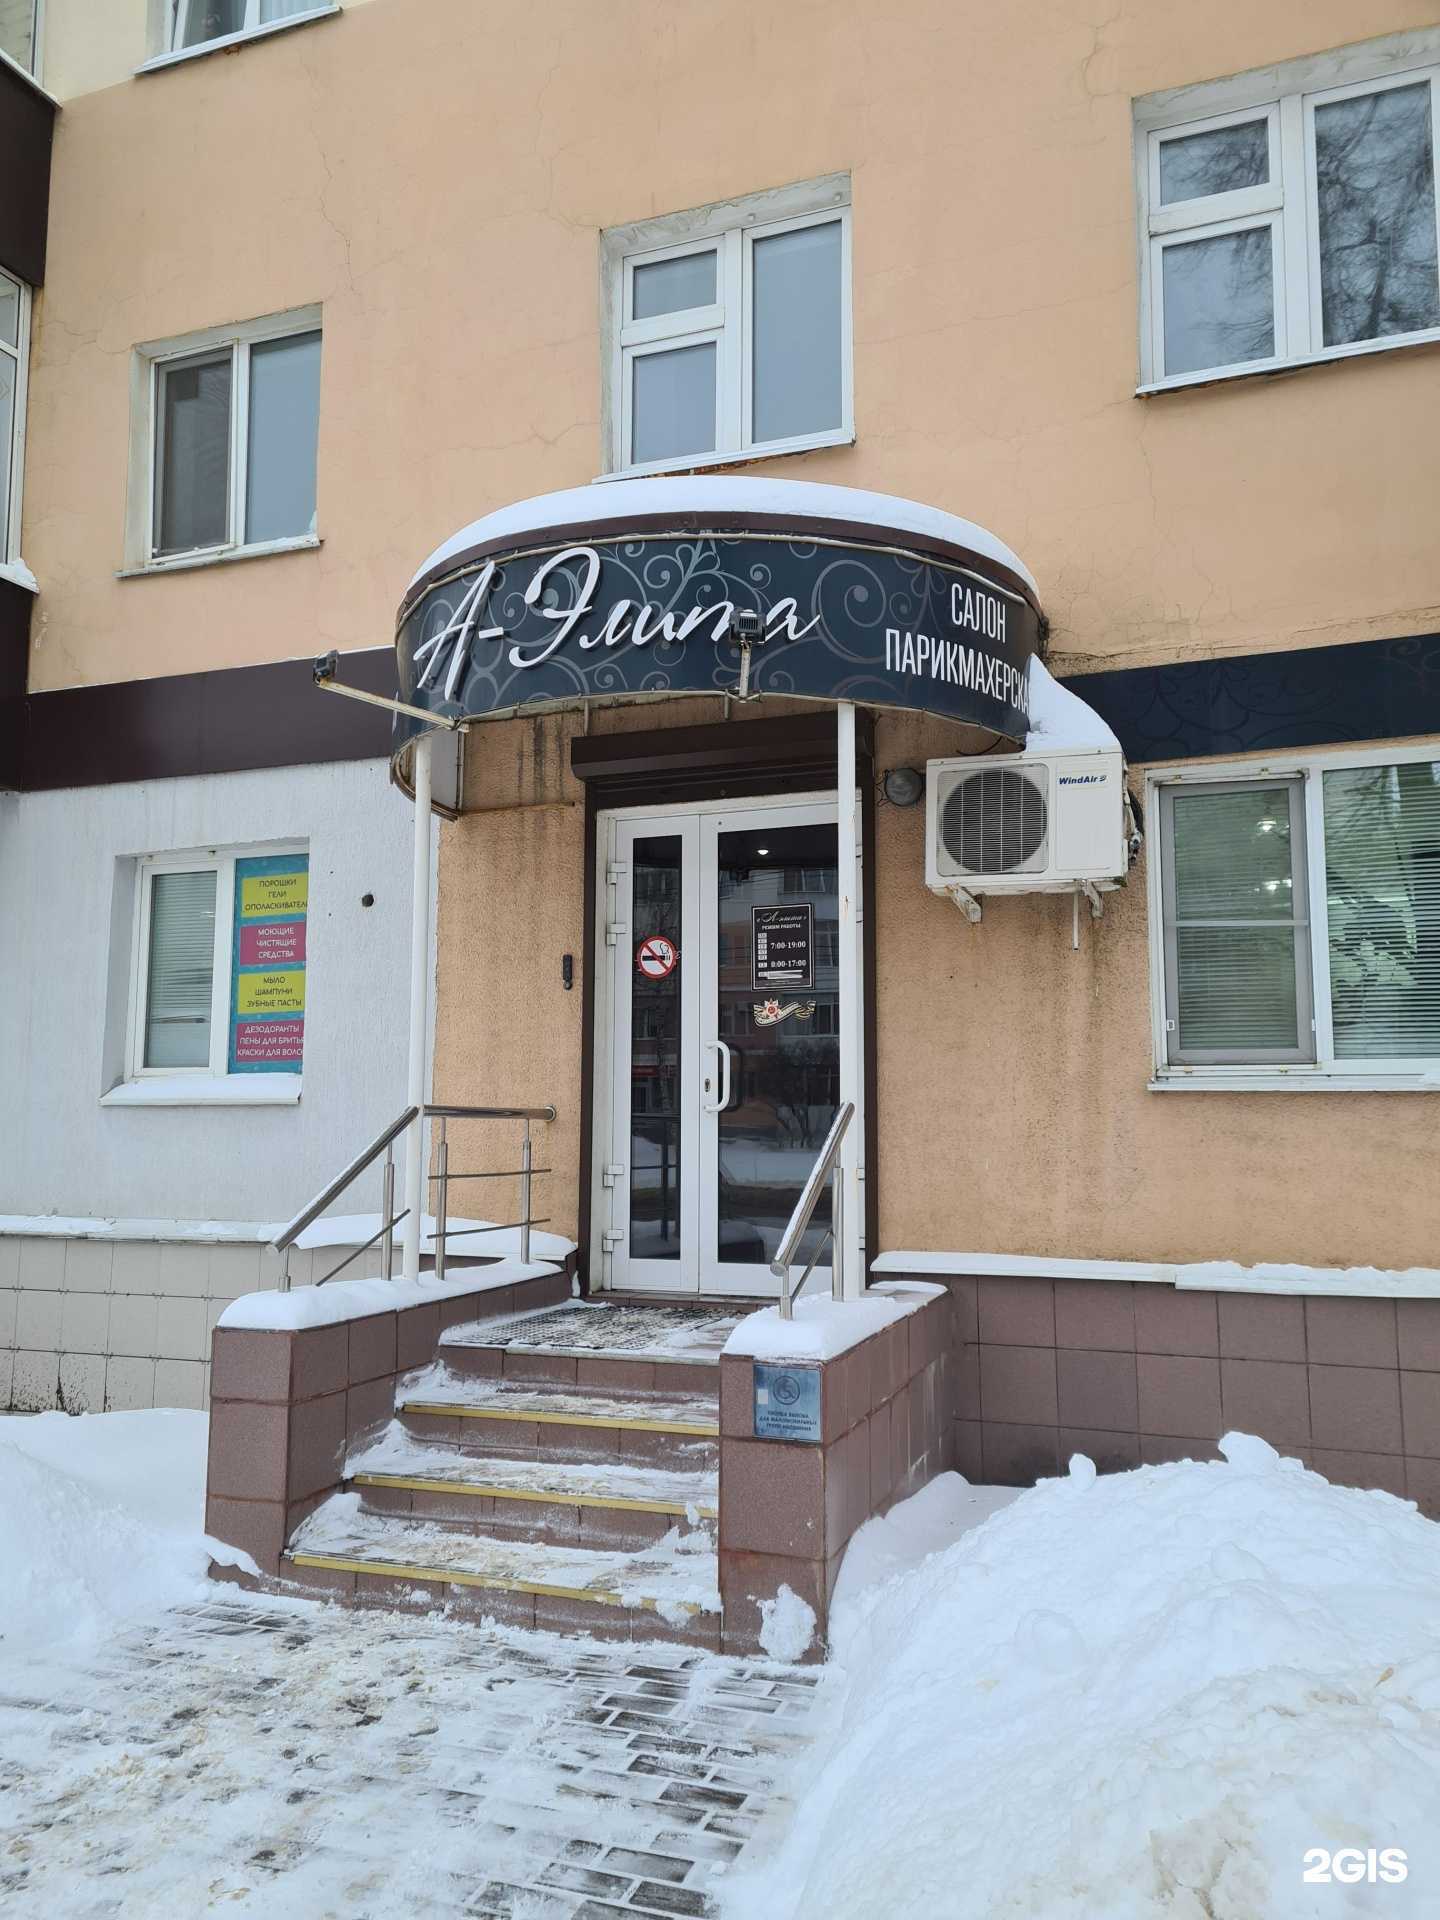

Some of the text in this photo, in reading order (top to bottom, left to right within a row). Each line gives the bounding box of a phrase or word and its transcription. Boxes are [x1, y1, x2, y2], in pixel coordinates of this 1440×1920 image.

[951, 583, 1006, 644] САЛОН
[885, 628, 1031, 714] ПАРИКМАХЕРСКА
[1059, 775, 1098, 785] WindAir
[259, 879, 297, 888] ПОРОШКИ
[268, 890, 287, 899] ГЕЛИ
[258, 927, 295, 936] МОЮЩИЕ
[256, 938, 297, 947] ЧИСТЯЩИЕ
[770, 940, 807, 949] 7:00-19:00
[258, 950, 295, 959] СРЕДСТВА
[263, 976, 286, 984] МЫЛО
[255, 988, 293, 996] ШАМПУНИ
[247, 999, 302, 1008] ЗУБНЫЕ ПАСТЫ
[245, 1025, 300, 1034] ДЕЗОДОРАНТЫ
[239, 1037, 261, 1045] ПЕНЫ
[262, 1037, 277, 1045] ДЛЯ
[237, 1048, 304, 1057] КРАСКИ ДЛЯ ВОЛО
